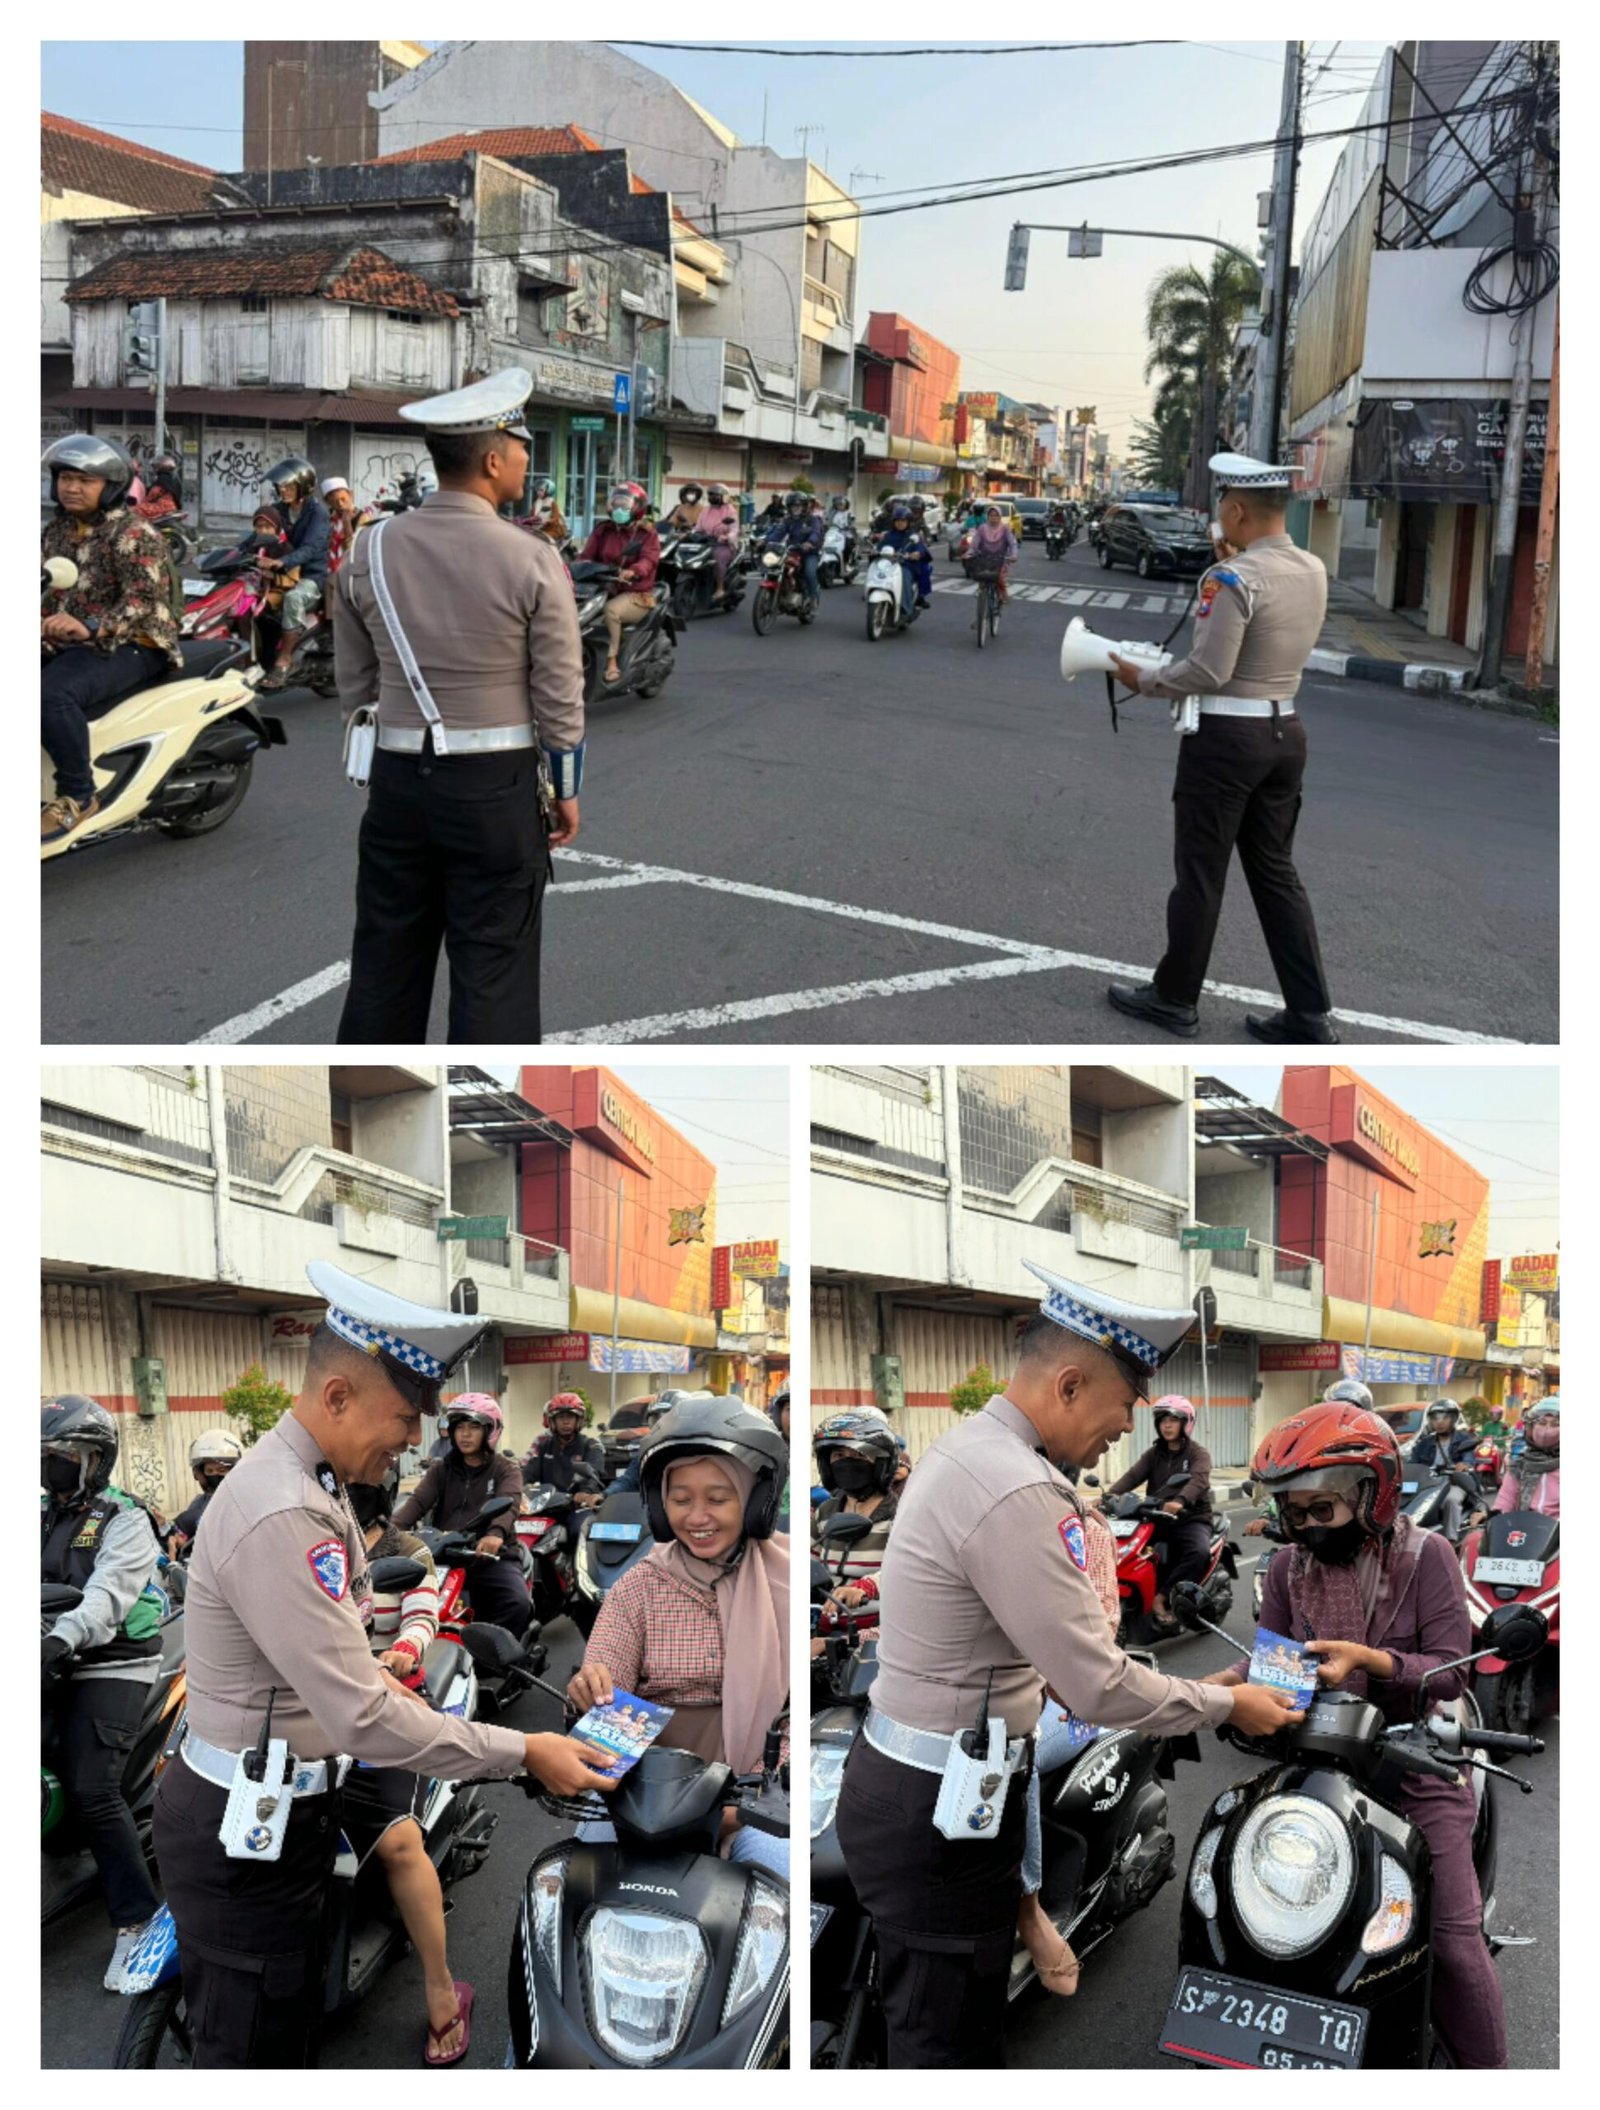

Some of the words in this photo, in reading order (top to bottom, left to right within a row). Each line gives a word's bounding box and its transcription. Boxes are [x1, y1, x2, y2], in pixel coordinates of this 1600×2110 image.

[733, 1240, 777, 1259] GADAI
[1511, 1254, 1556, 1272] GADAI
[508, 1338, 550, 1350] CENTRA
[552, 1336, 585, 1348] MODA
[1263, 1346, 1302, 1356] CENTRA
[1304, 1345, 1336, 1356] MODA
[618, 1881, 680, 1898] HONDA
[1181, 1986, 1199, 2014] S
[1220, 1995, 1288, 2035] 2348
